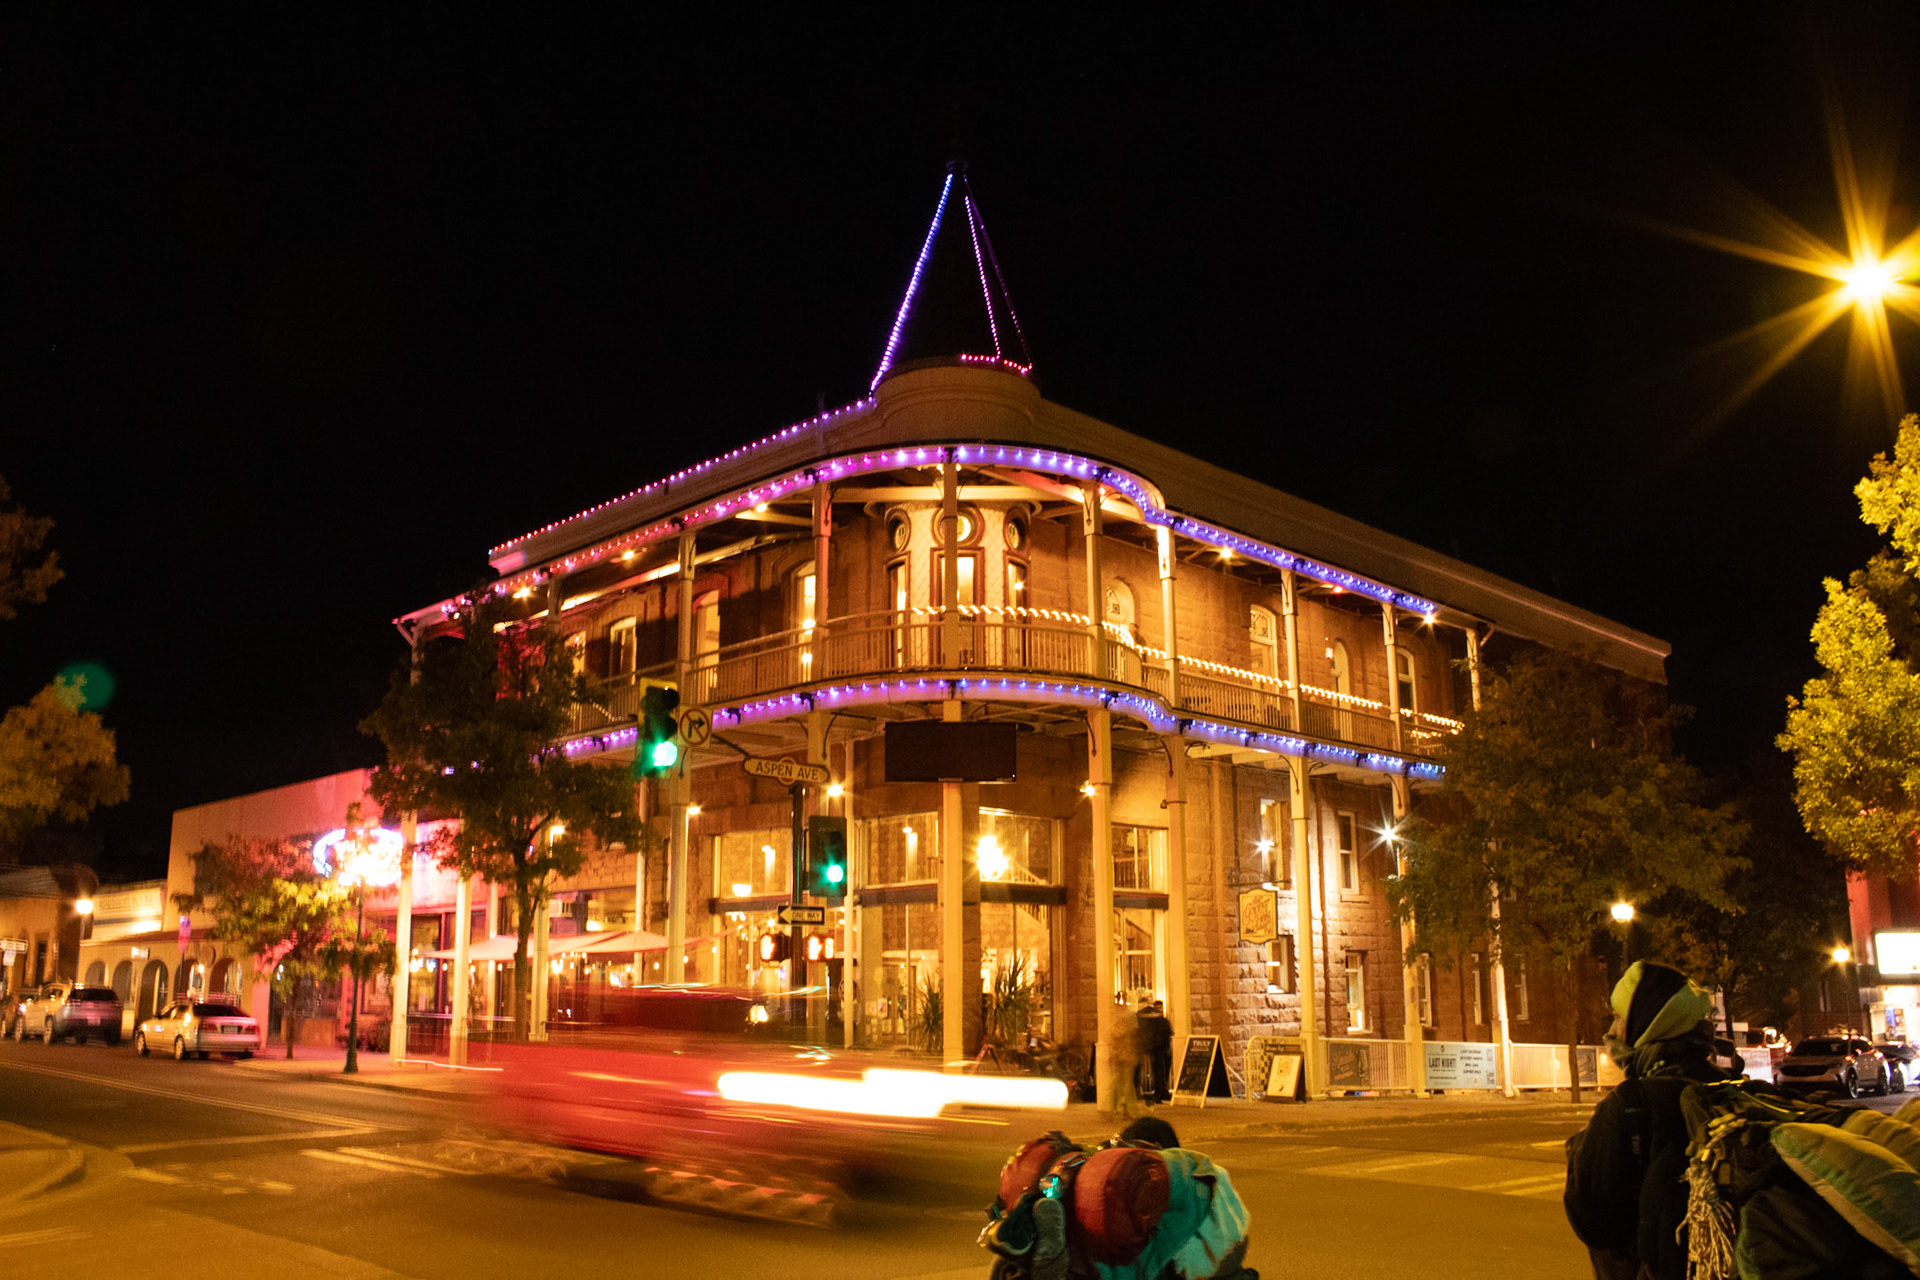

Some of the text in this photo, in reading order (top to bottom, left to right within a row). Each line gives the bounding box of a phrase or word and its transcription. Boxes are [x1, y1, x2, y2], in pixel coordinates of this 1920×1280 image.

[755, 761, 819, 780] ASPEN AVE
[792, 911, 820, 920] ONE WAY
[1429, 1057, 1440, 1068] LAST
